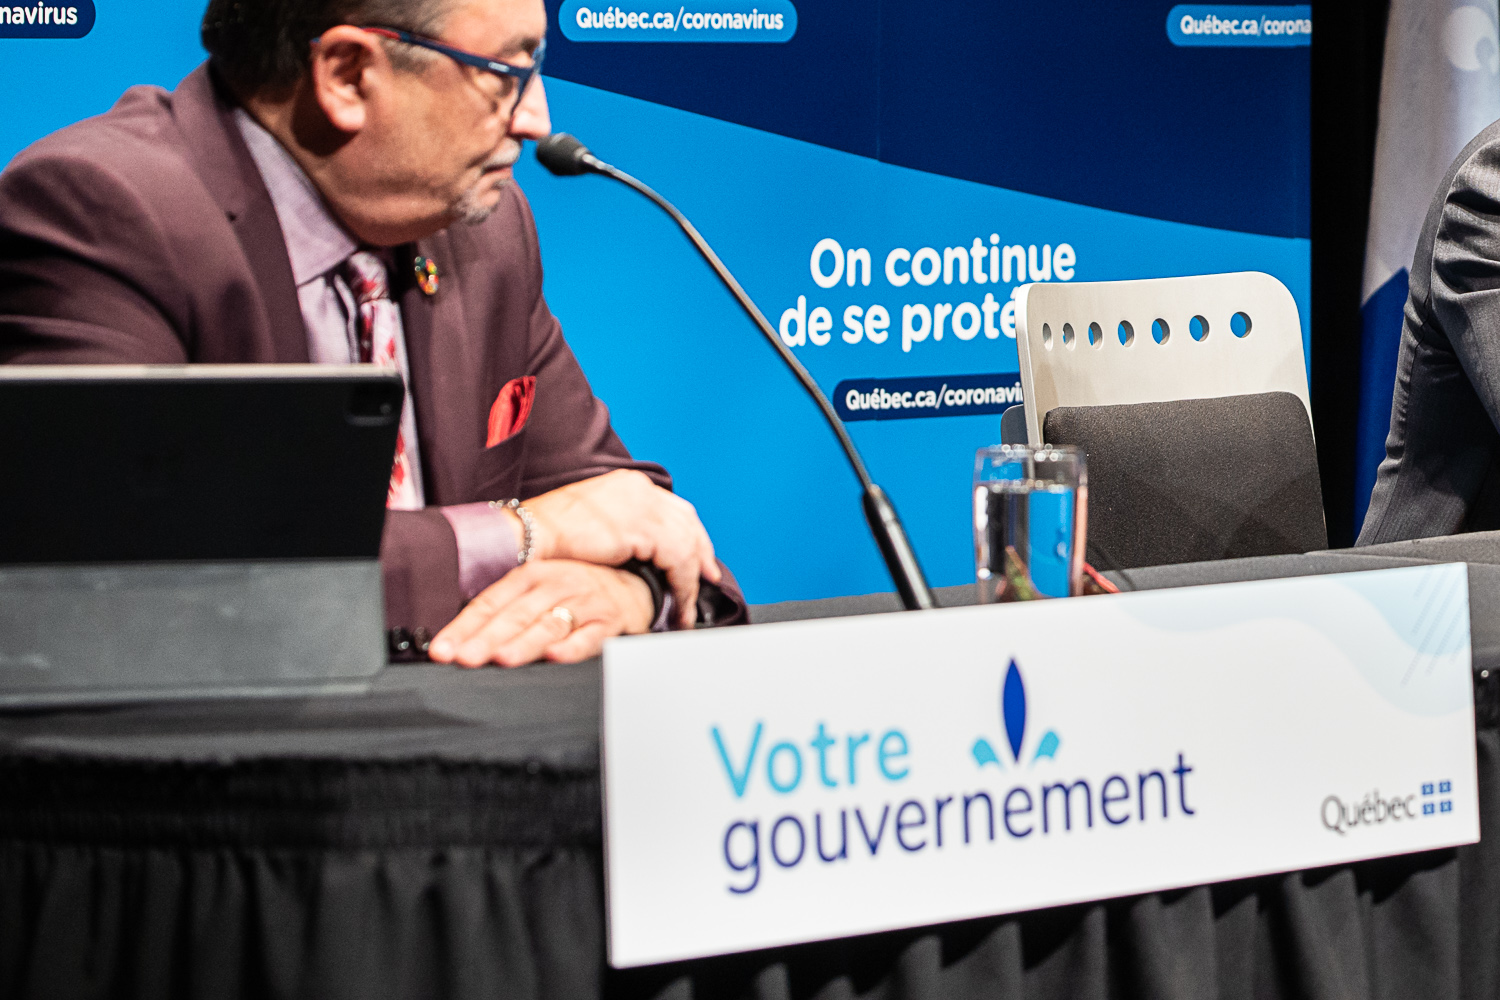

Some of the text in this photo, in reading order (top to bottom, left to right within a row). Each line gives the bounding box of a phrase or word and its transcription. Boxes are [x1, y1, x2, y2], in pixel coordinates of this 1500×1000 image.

[576, 6, 784, 31] Québec.ca/coronavirus
[810, 233, 1076, 288] On continue
[779, 295, 833, 347] de
[842, 305, 890, 344] se
[709, 721, 911, 799] Votre
[722, 751, 1197, 895] gouvernement
[1320, 790, 1418, 836] Québec
